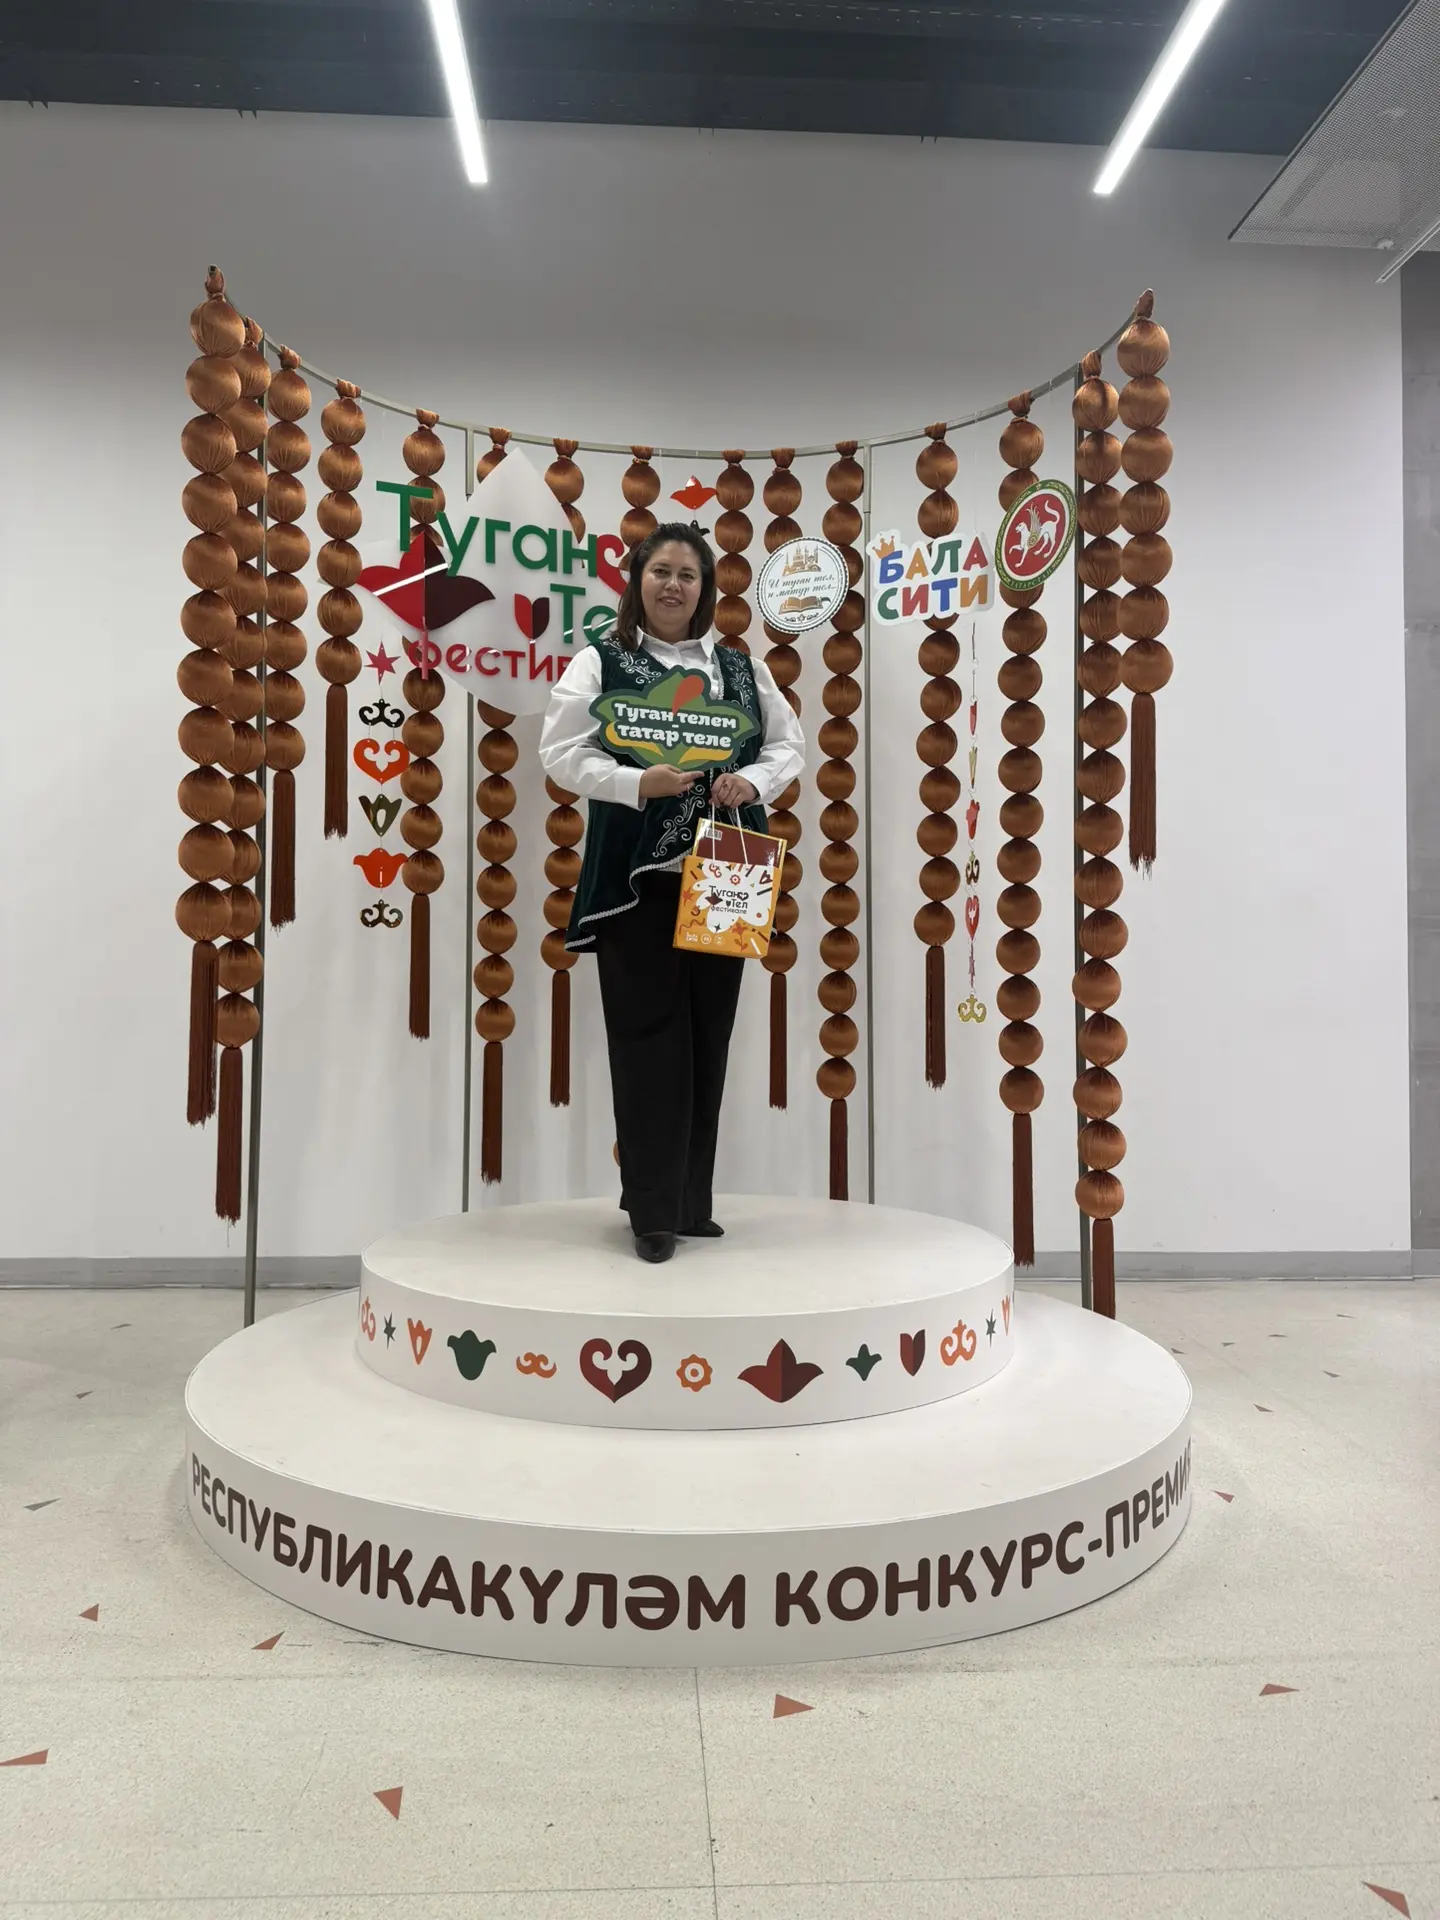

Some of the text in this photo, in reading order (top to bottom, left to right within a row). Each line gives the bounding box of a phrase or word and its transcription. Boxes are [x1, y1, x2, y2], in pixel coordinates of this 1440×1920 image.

[376, 480, 598, 578] Туган
[879, 536, 989, 585] БАЛА
[549, 583, 619, 644] Те
[877, 574, 989, 620] СИТИ
[614, 703, 737, 729] Туган телем
[617, 724, 732, 747] татар теле
[709, 885, 740, 898] Туган
[731, 899, 748, 909] Тел
[192, 1452, 747, 1631] РЕСПУБЛИКАКҮЛӘМ
